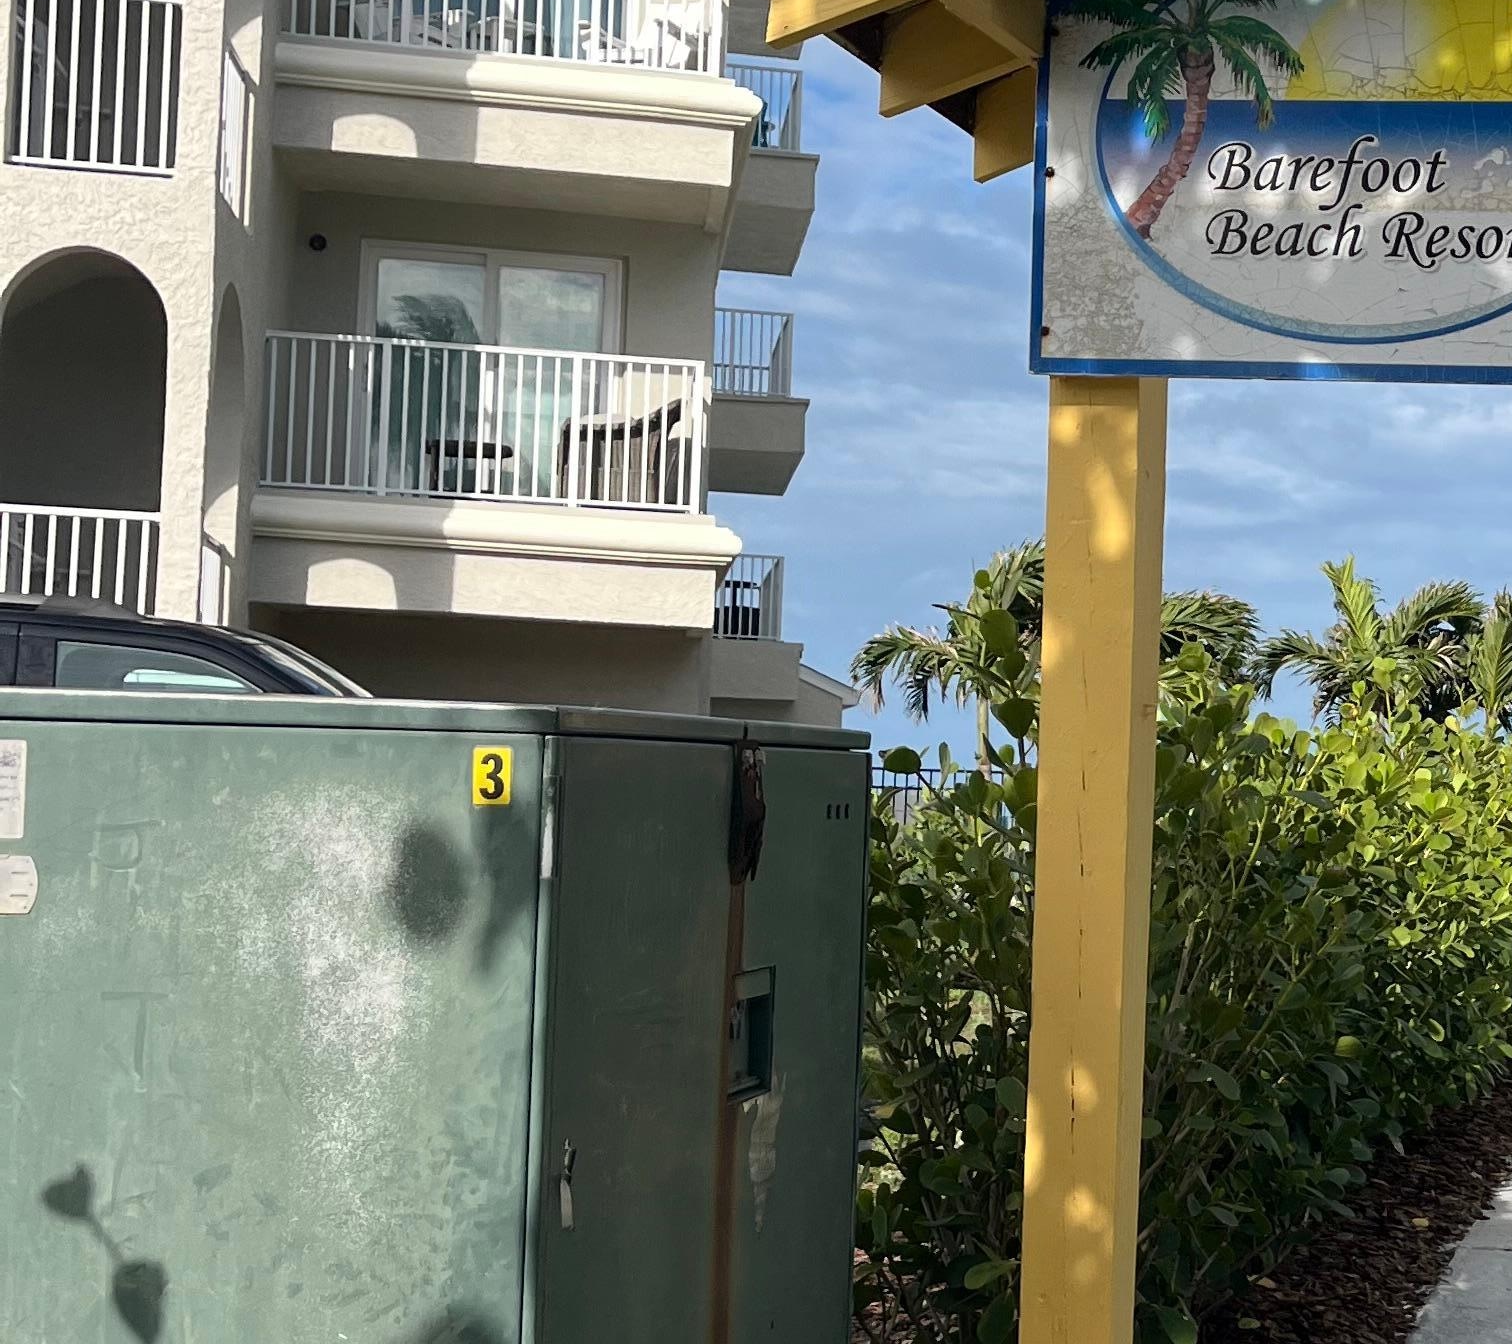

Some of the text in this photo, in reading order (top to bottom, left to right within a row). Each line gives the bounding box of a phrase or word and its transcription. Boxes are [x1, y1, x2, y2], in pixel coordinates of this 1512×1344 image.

[1206, 135, 1447, 211] Barefoot
[1204, 203, 1363, 258] Beach
[479, 753, 504, 800] 3
